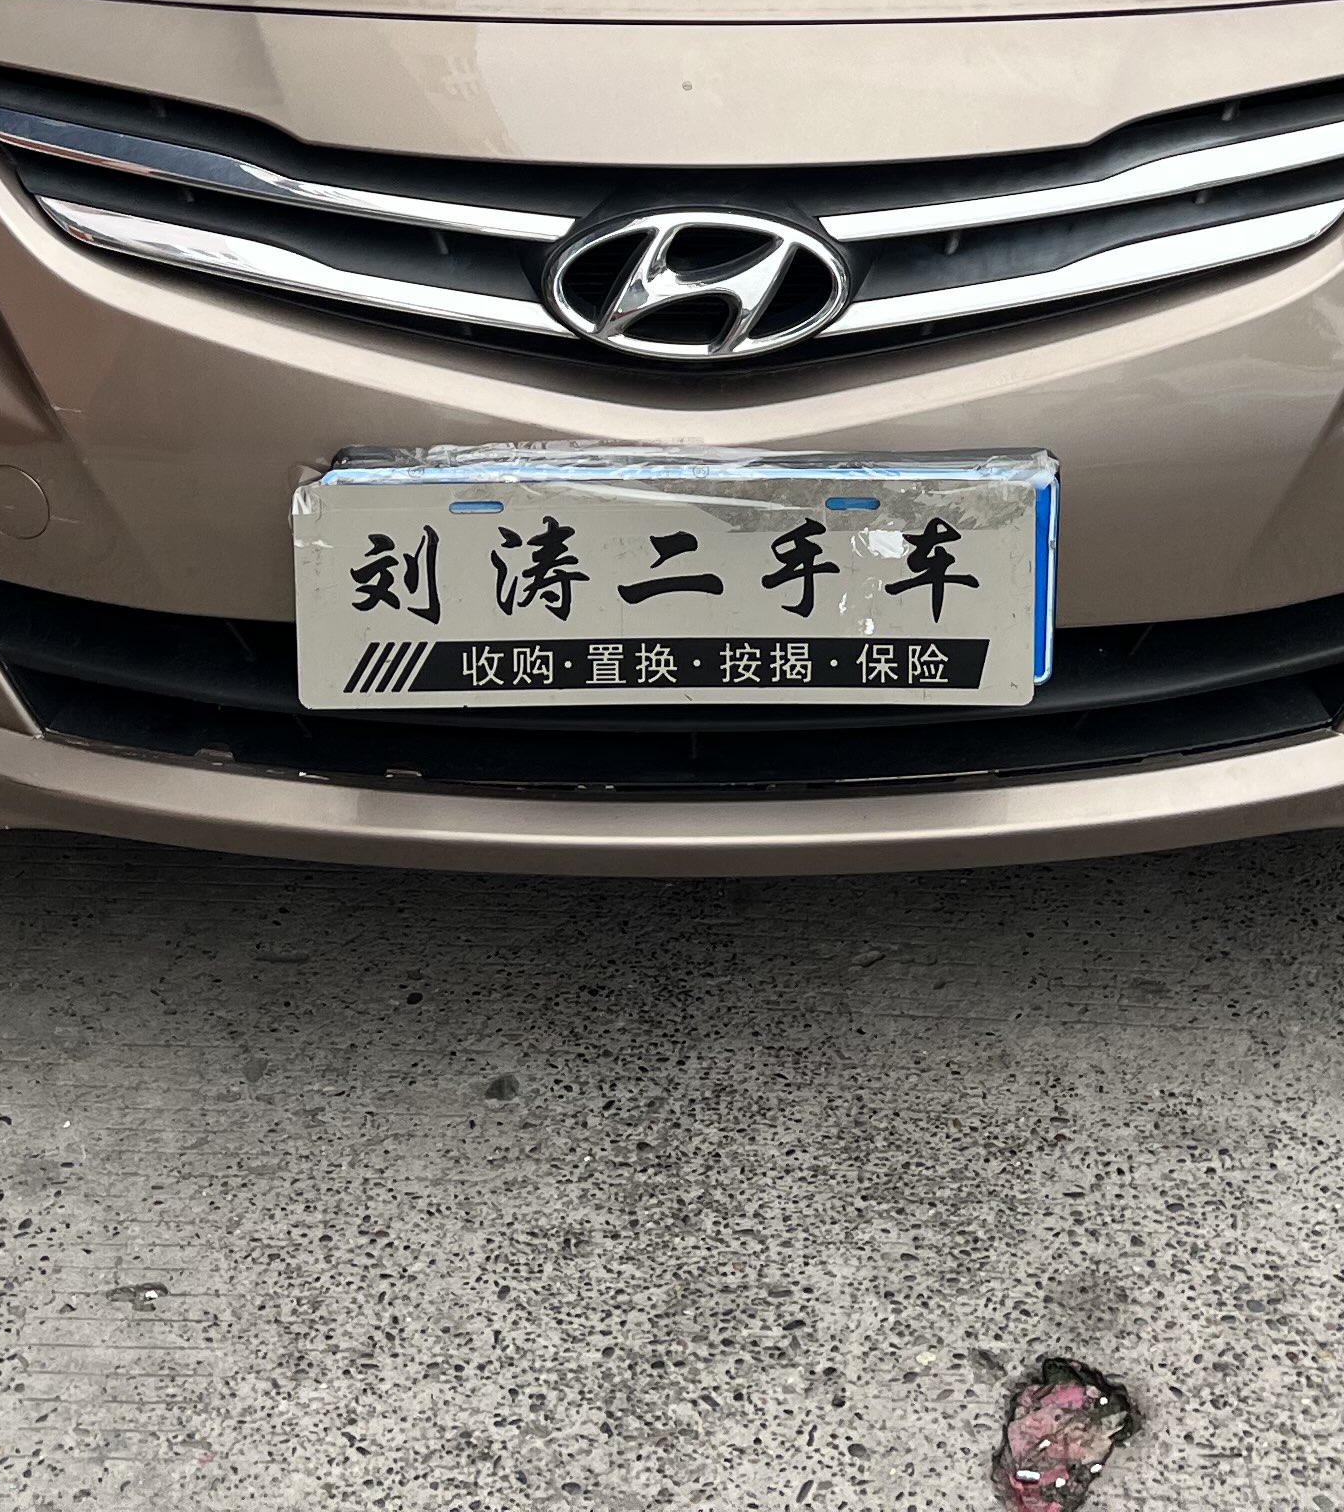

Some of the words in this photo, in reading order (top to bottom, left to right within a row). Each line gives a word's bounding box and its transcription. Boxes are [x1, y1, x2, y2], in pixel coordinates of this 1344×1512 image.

[350, 516, 980, 624] 刘涛二手车
